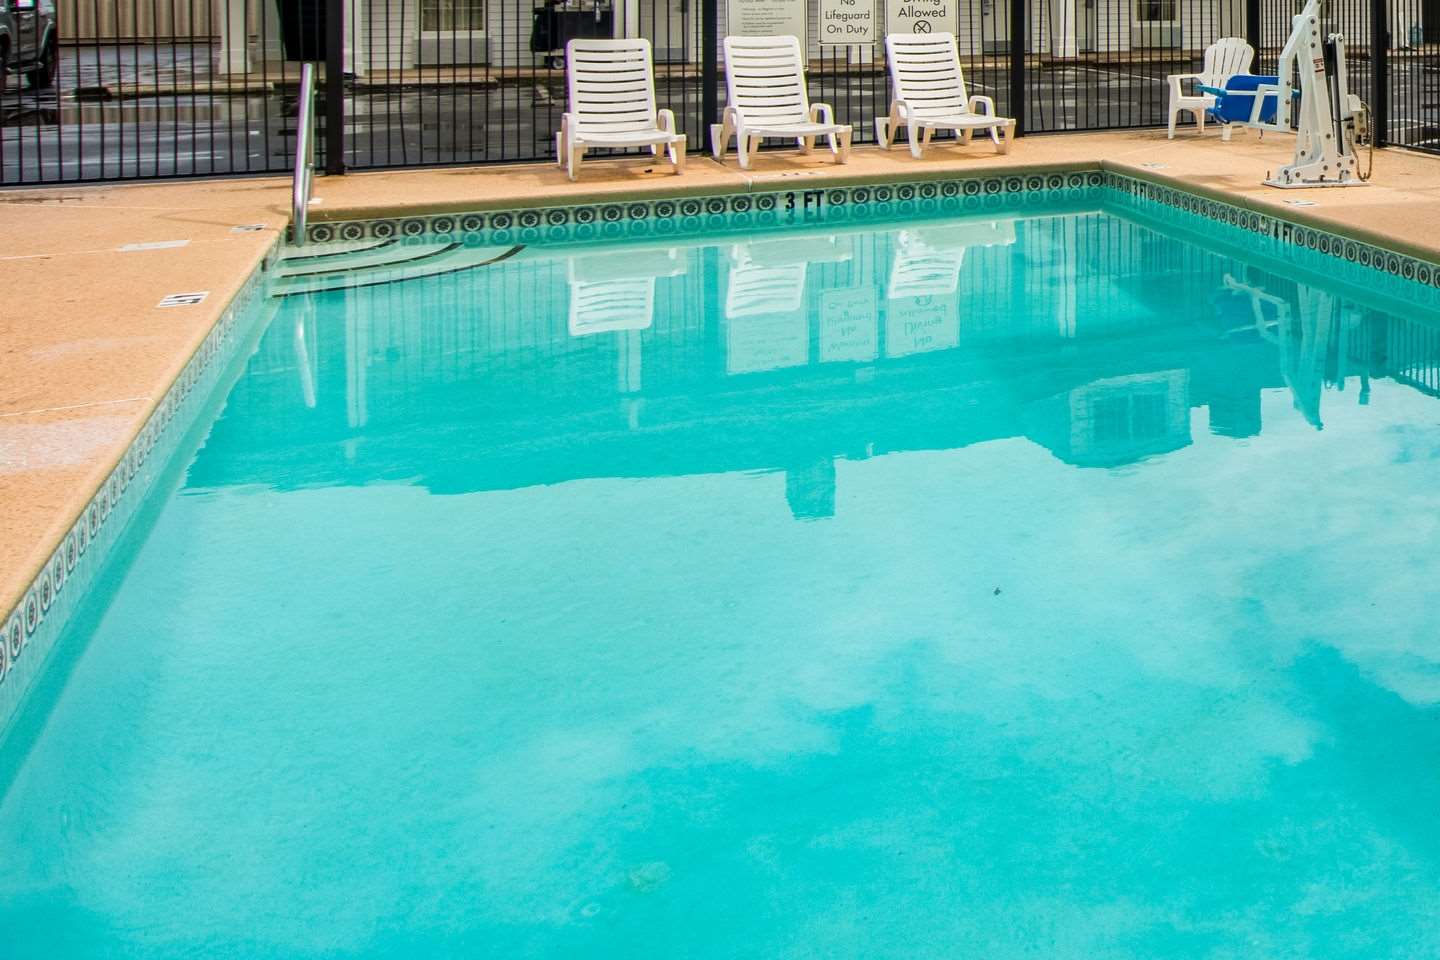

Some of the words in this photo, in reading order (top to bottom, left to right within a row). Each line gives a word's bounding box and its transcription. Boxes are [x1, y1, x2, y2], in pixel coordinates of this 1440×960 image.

[825, 9, 871, 22] Lifeguard
[897, 5, 946, 18] Allowed
[826, 24, 843, 34] On
[846, 24, 869, 36] Duty
[784, 191, 796, 209] 3
[803, 189, 825, 209] FT
[1282, 222, 1294, 244] FT
